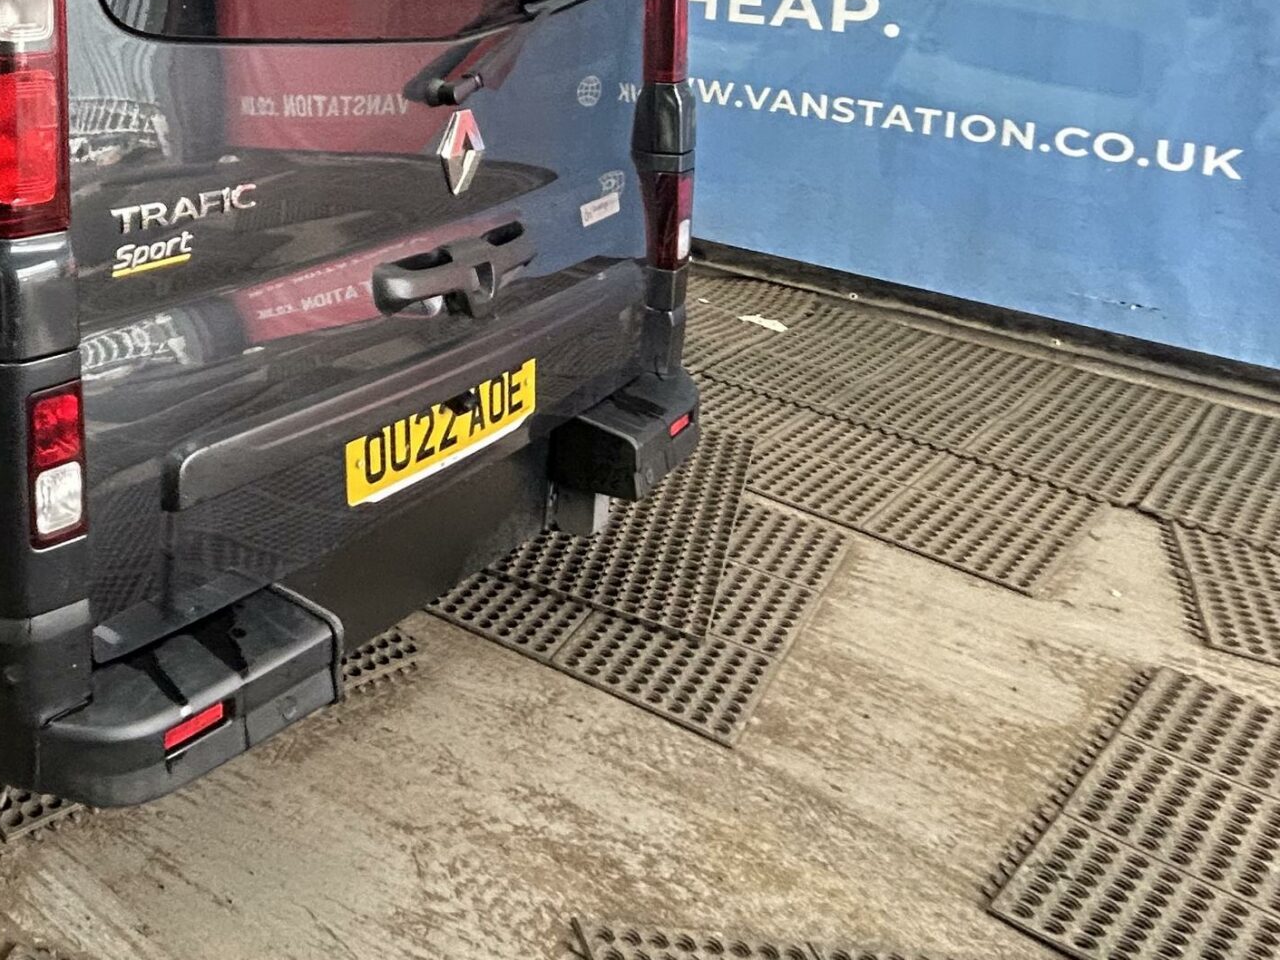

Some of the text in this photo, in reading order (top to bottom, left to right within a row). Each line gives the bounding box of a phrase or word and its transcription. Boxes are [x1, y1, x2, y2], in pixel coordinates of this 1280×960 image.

[689, 77, 1245, 181] W.VANSTATION.CO.UK
[110, 183, 257, 234] TRAFIC
[112, 230, 194, 270] Sport
